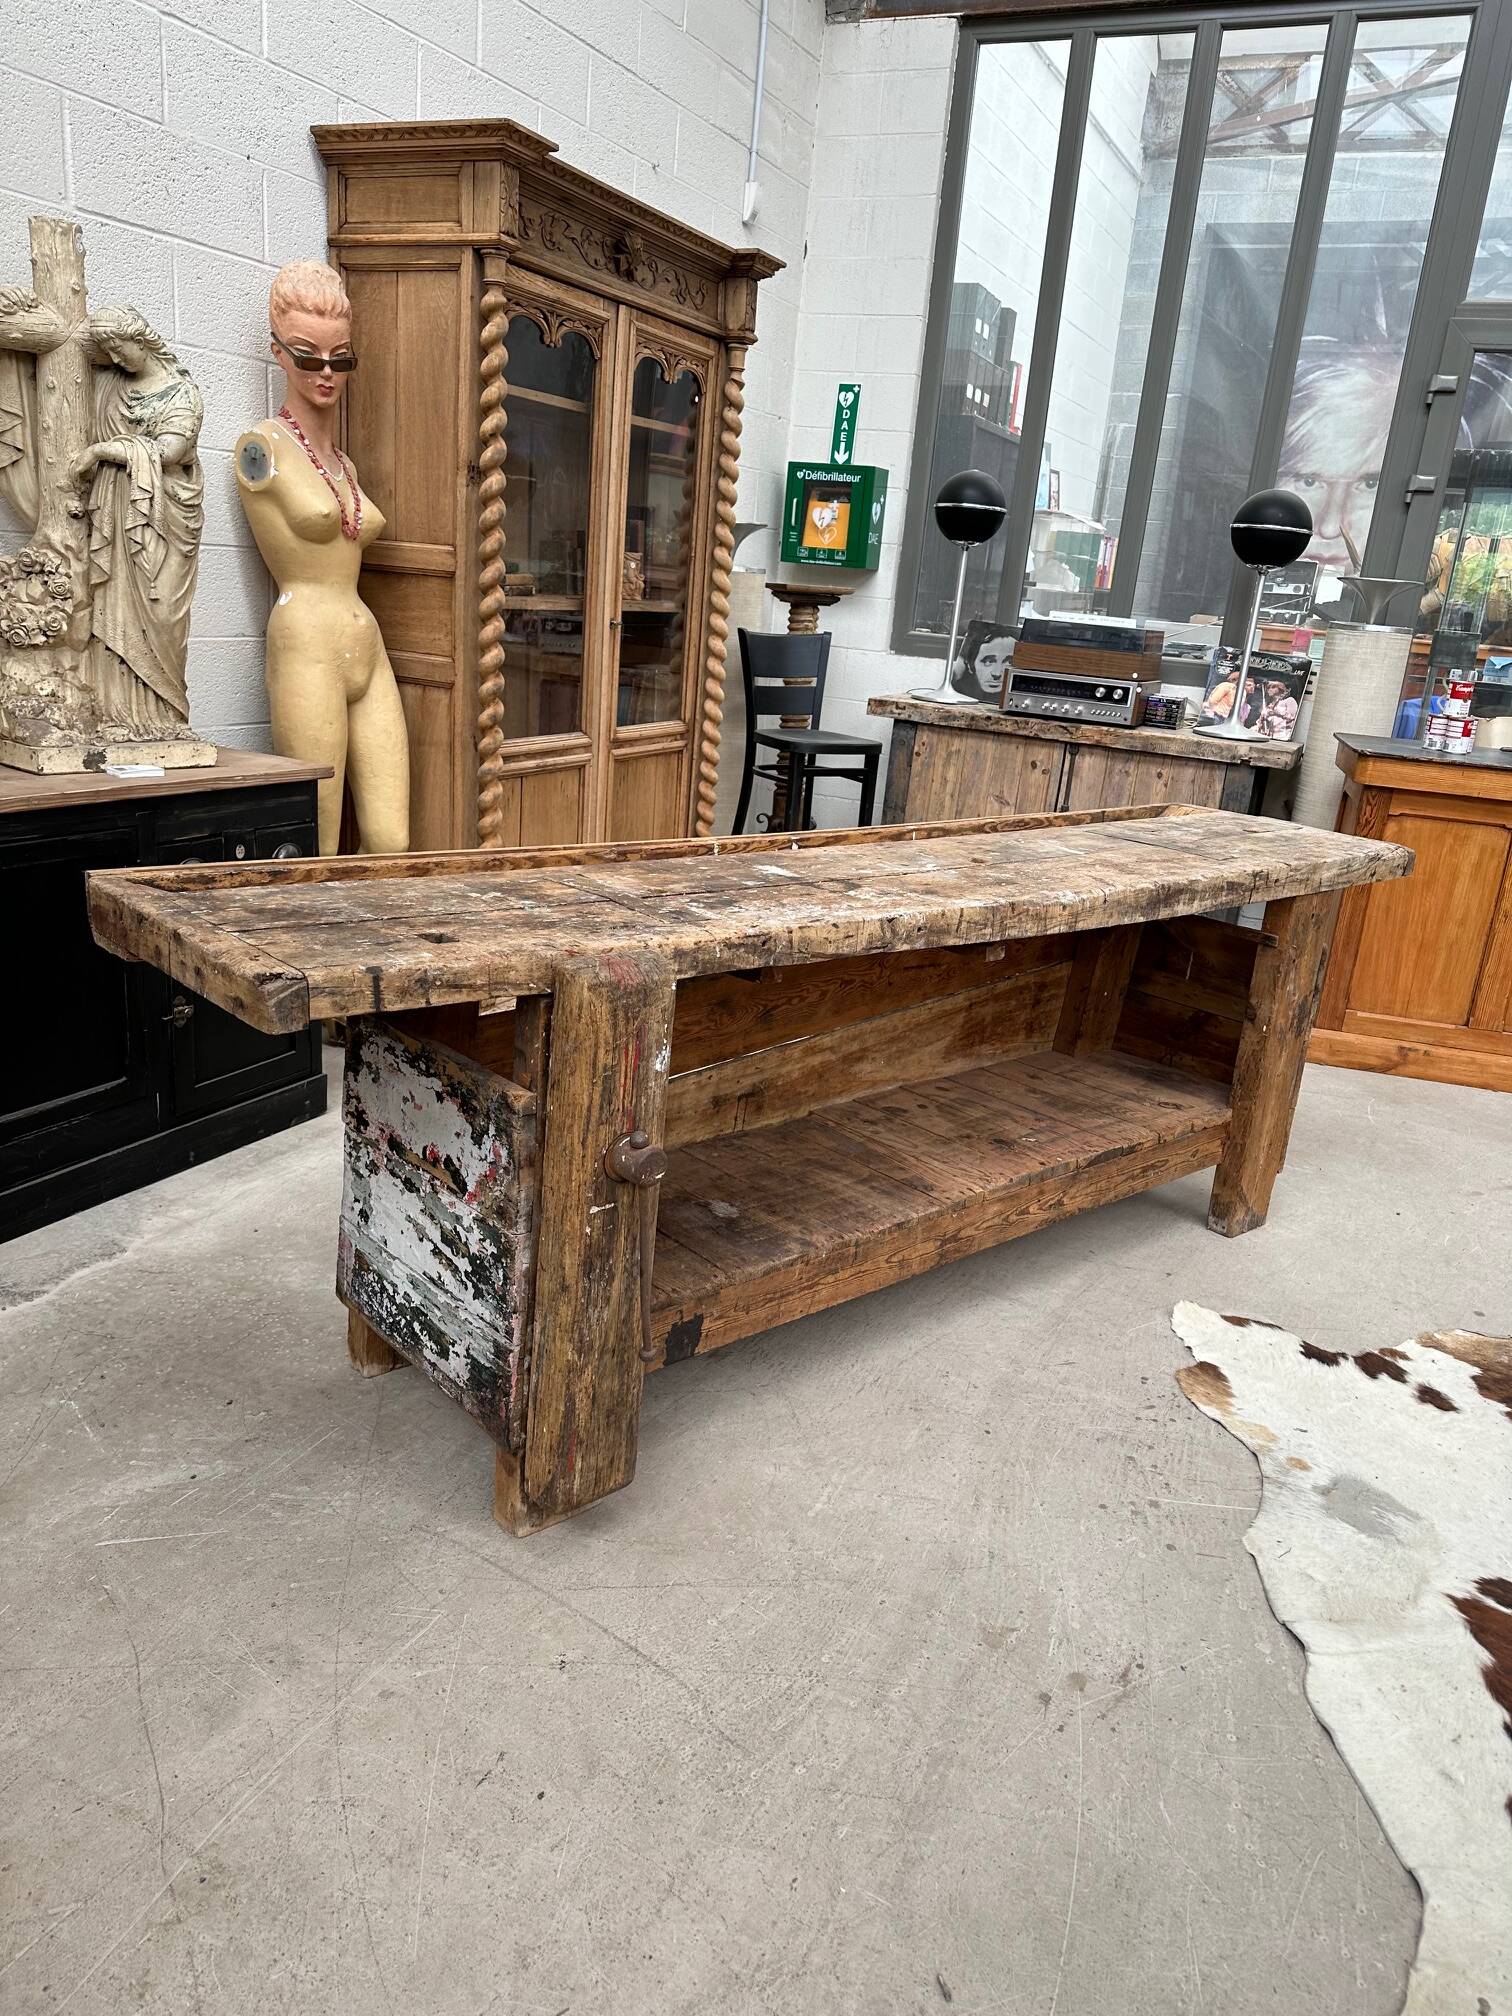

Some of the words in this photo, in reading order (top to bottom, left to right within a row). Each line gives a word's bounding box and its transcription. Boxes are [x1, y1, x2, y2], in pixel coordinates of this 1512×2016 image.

[840, 409, 851, 441] DAE
[805, 470, 861, 483] Défibrillateur
[868, 532, 879, 544] DAE
